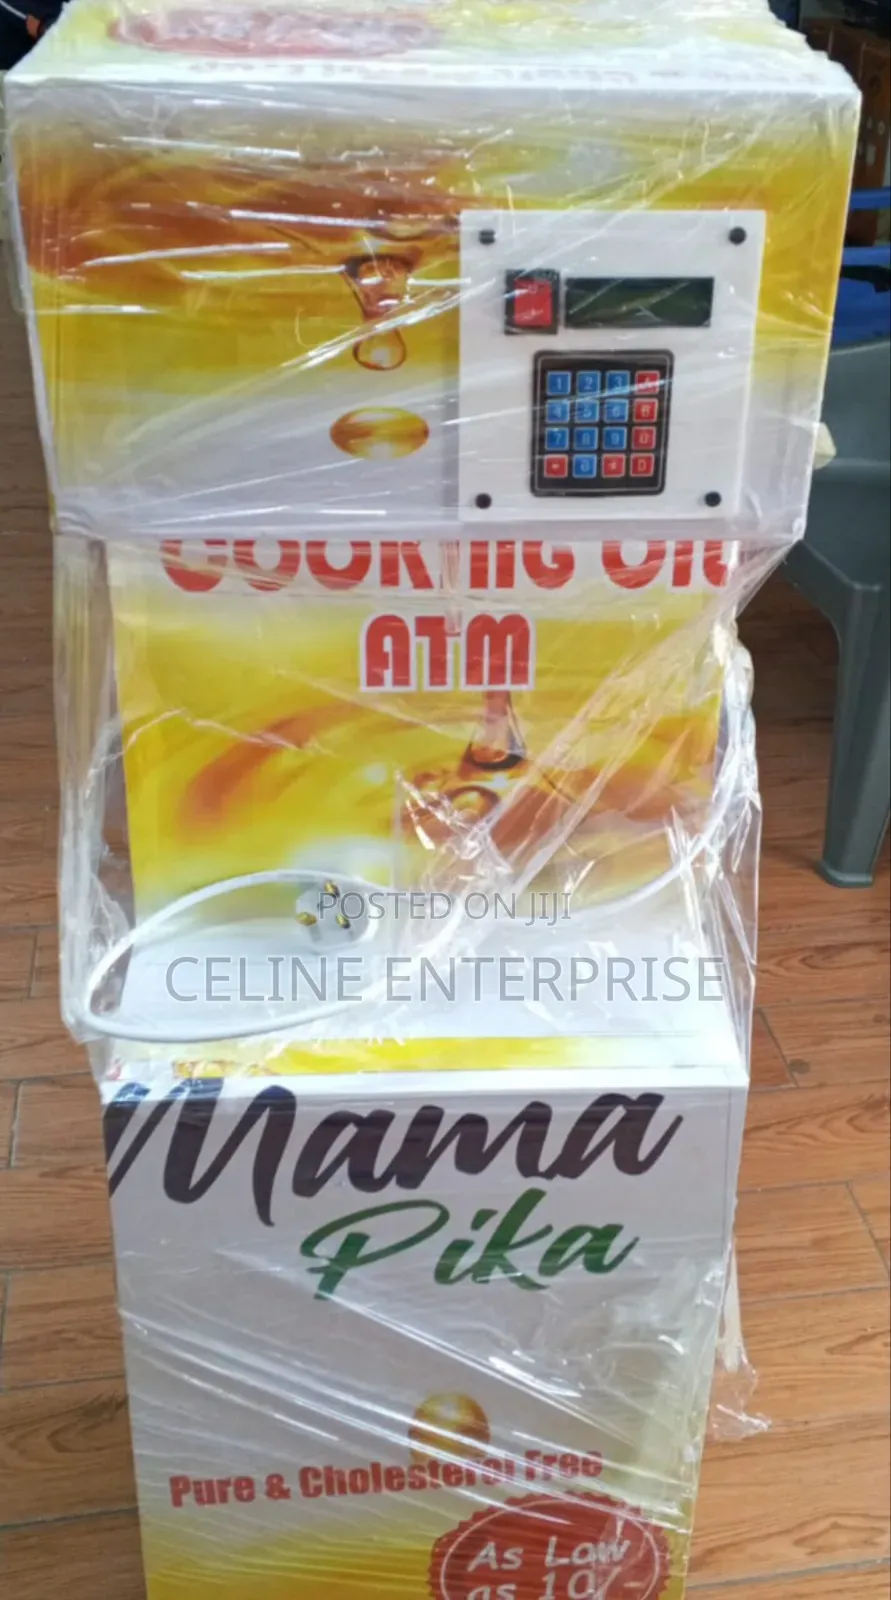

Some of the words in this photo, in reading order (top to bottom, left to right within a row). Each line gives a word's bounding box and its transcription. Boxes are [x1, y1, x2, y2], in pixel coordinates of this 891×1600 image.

[584, 376, 593, 390] 2
[610, 432, 619, 445] 9
[364, 613, 530, 687] ATM
[104, 1077, 682, 1227] Mama
[300, 1188, 640, 1300] Pika
[169, 1475, 256, 1508] Pure
[265, 1474, 291, 1501] &
[299, 1457, 515, 1499] Cholesterol
[524, 1449, 603, 1481] Free
[467, 1541, 524, 1572] As
[545, 1536, 631, 1567] Low
